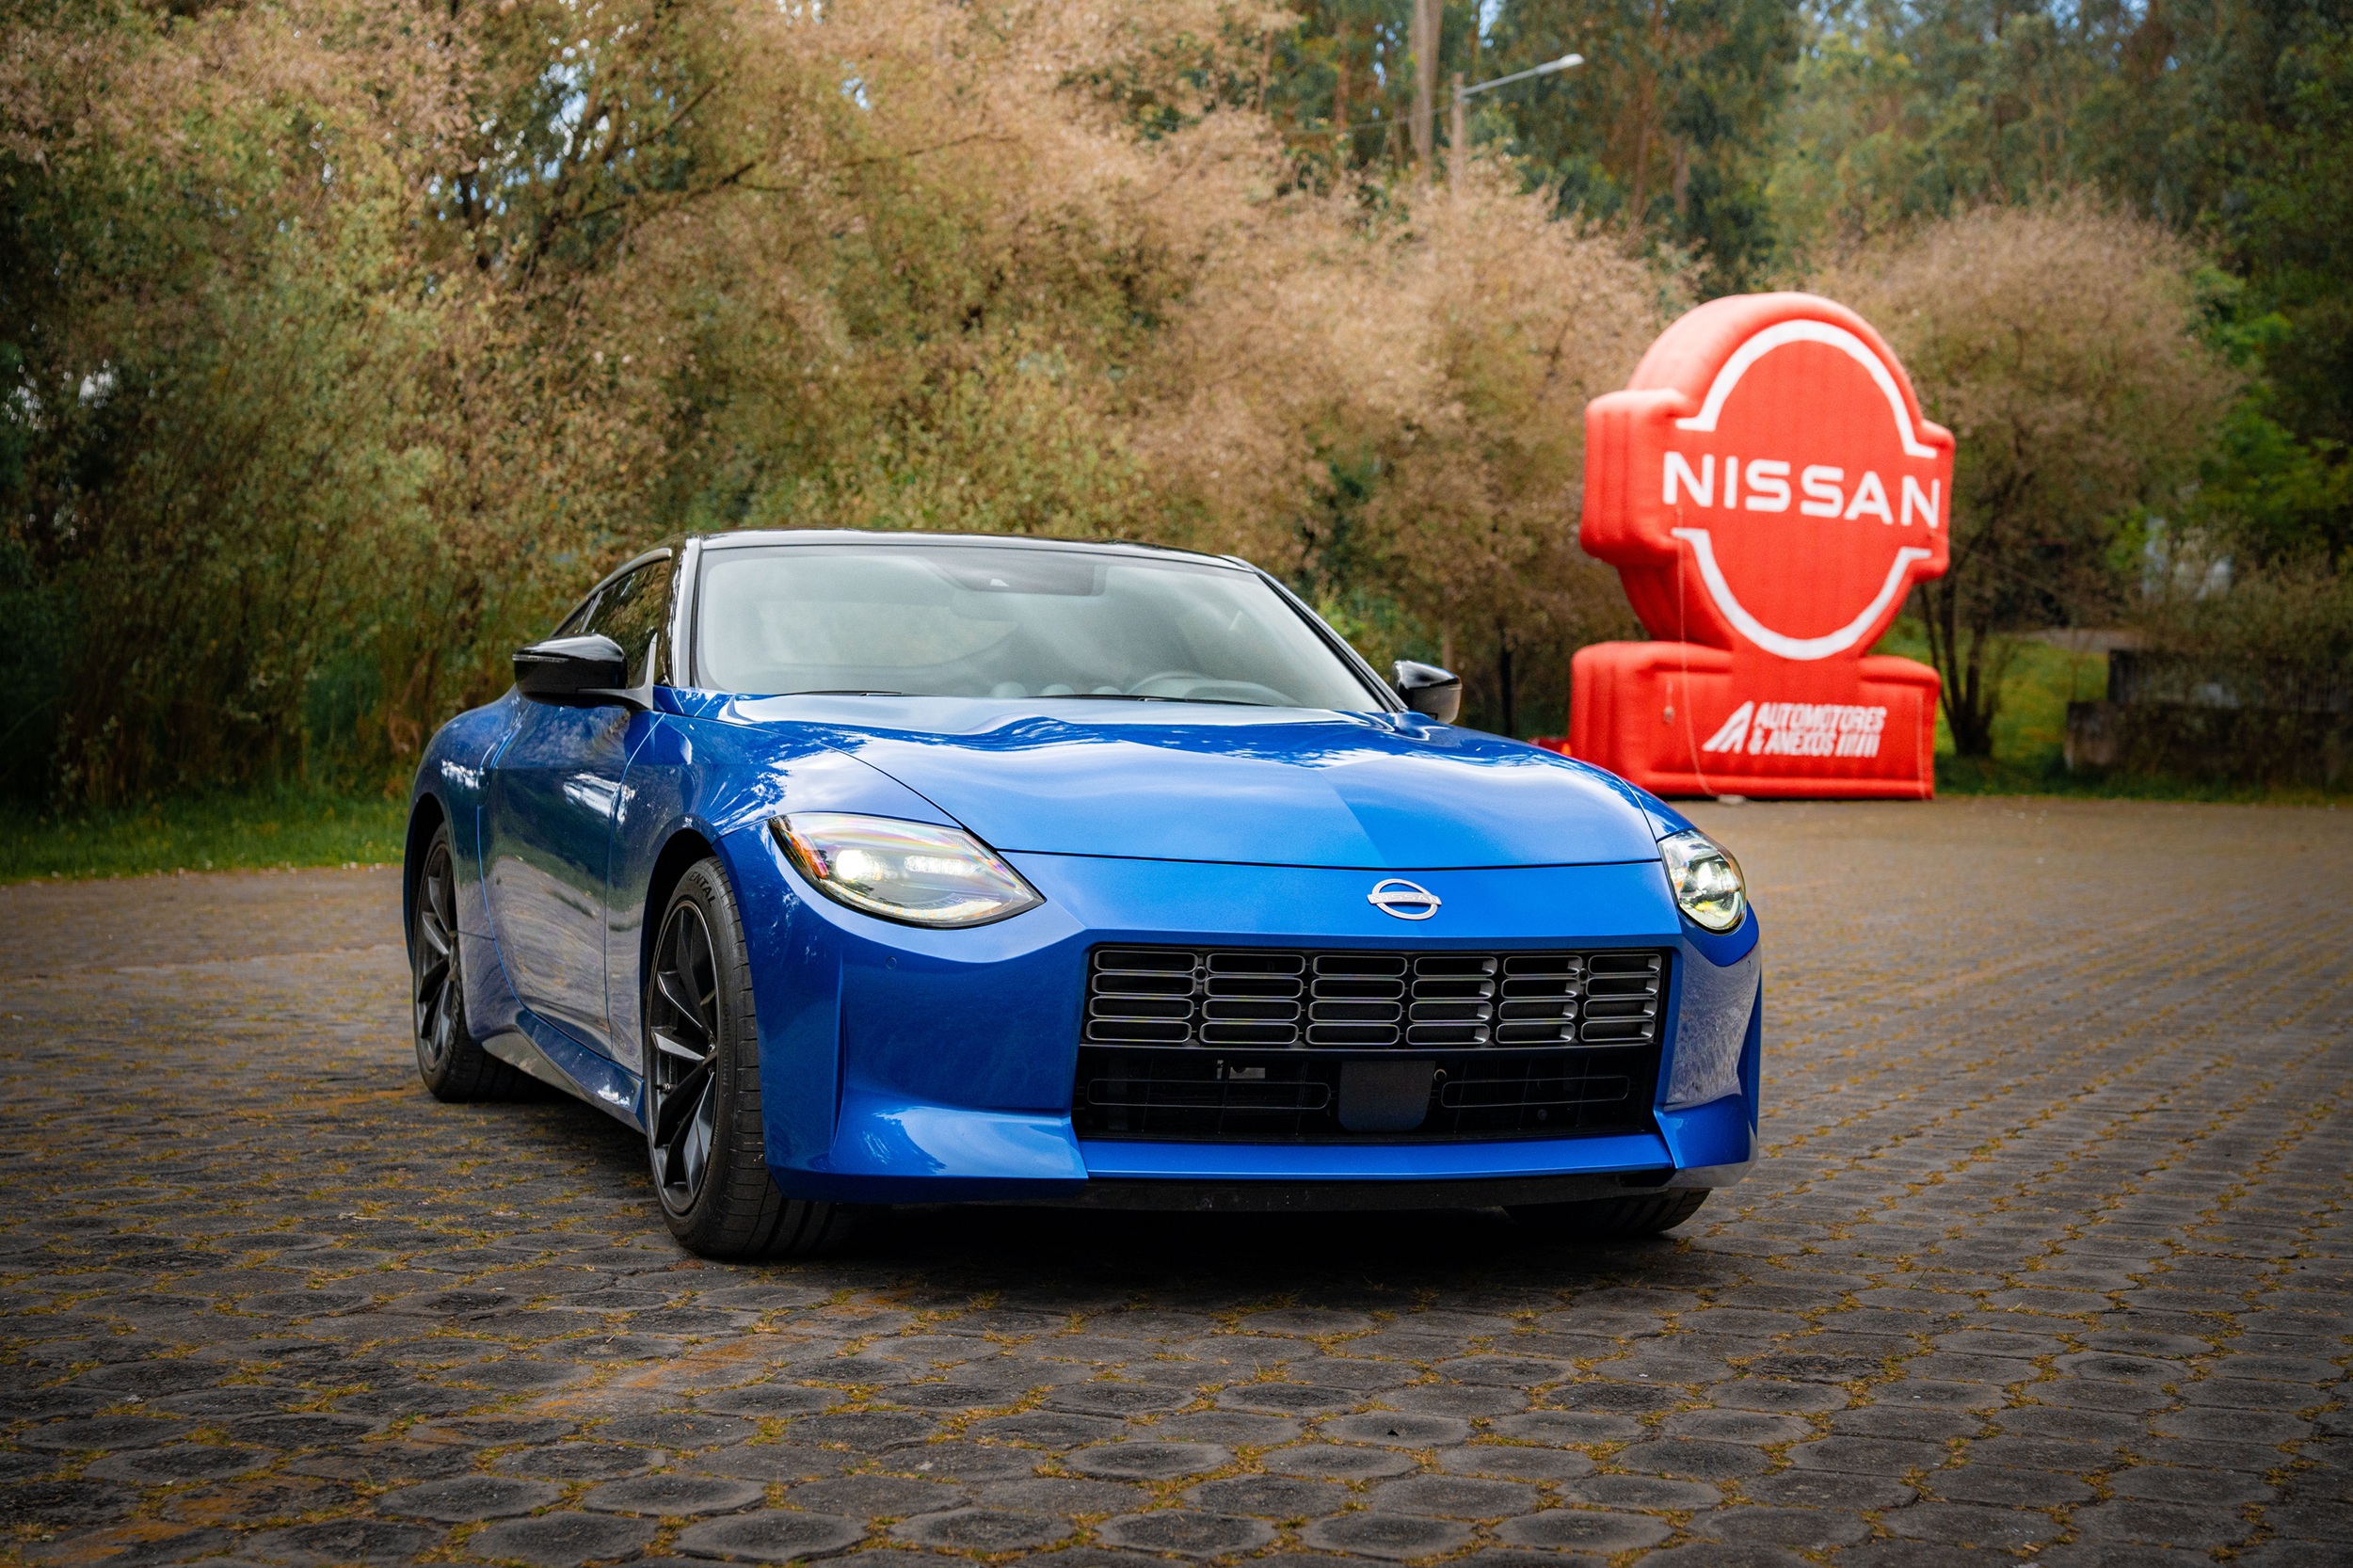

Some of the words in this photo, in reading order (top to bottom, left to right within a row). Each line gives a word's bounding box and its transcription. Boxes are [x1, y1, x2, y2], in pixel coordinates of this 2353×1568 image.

[1662, 451, 1941, 529] NISSAN
[1754, 702, 1887, 735] AUTOMOTORES
[1369, 893, 1442, 904] NISSAN
